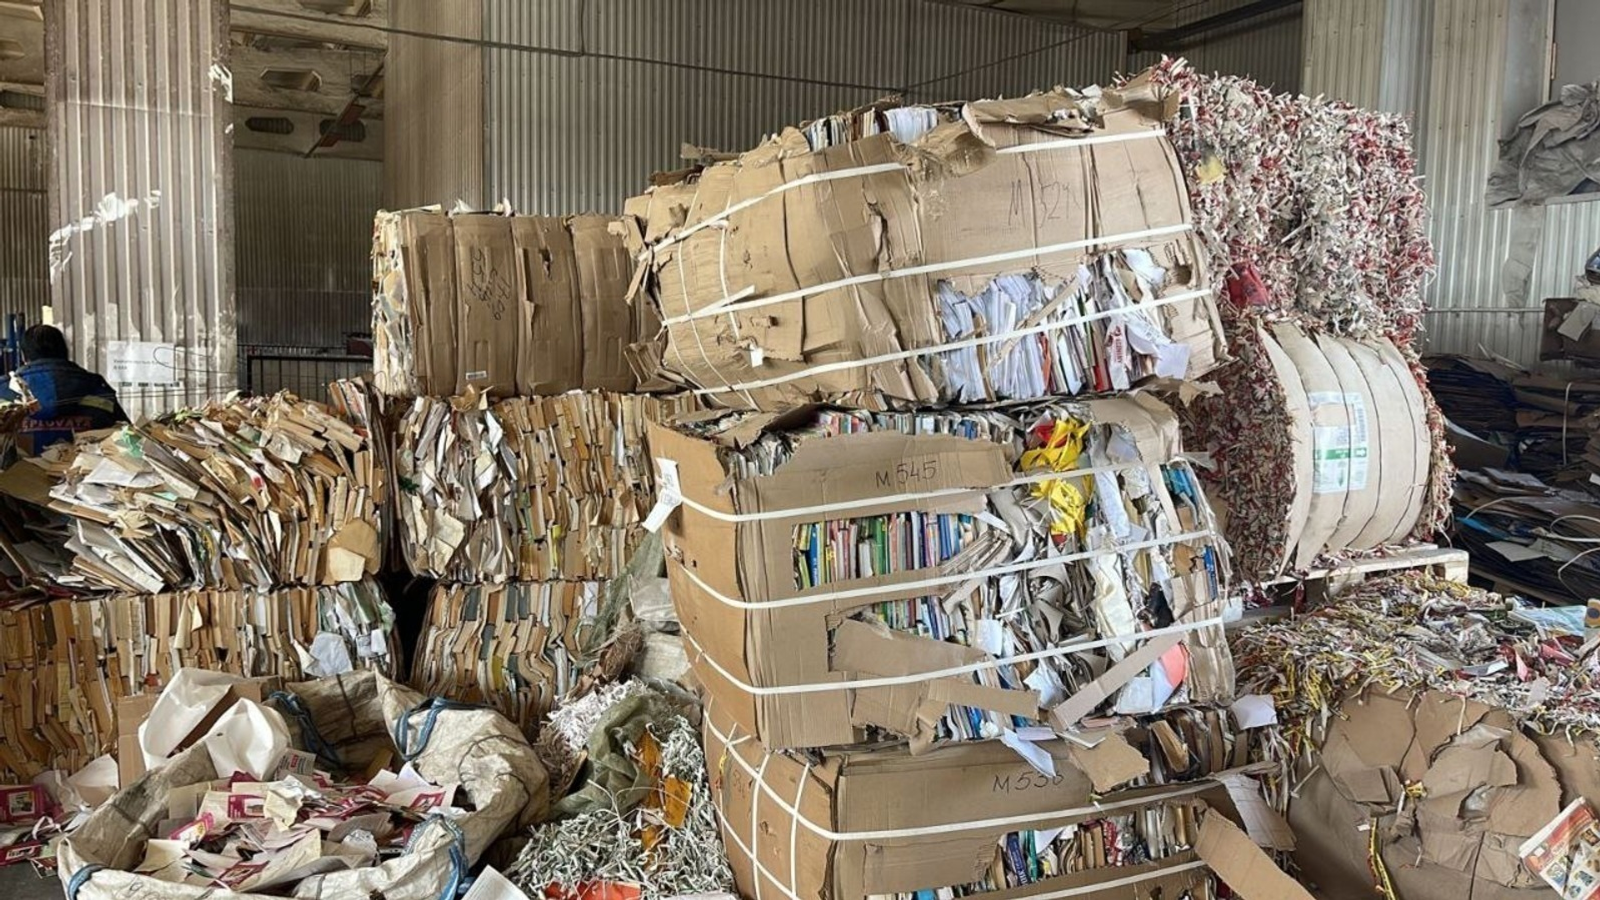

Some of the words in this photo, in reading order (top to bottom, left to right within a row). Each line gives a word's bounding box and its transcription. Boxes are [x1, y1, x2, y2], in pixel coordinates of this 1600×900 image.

[1005, 176, 1021, 221] M
[875, 470, 891, 488] M
[896, 460, 937, 484] 545
[992, 774, 1009, 794] M
